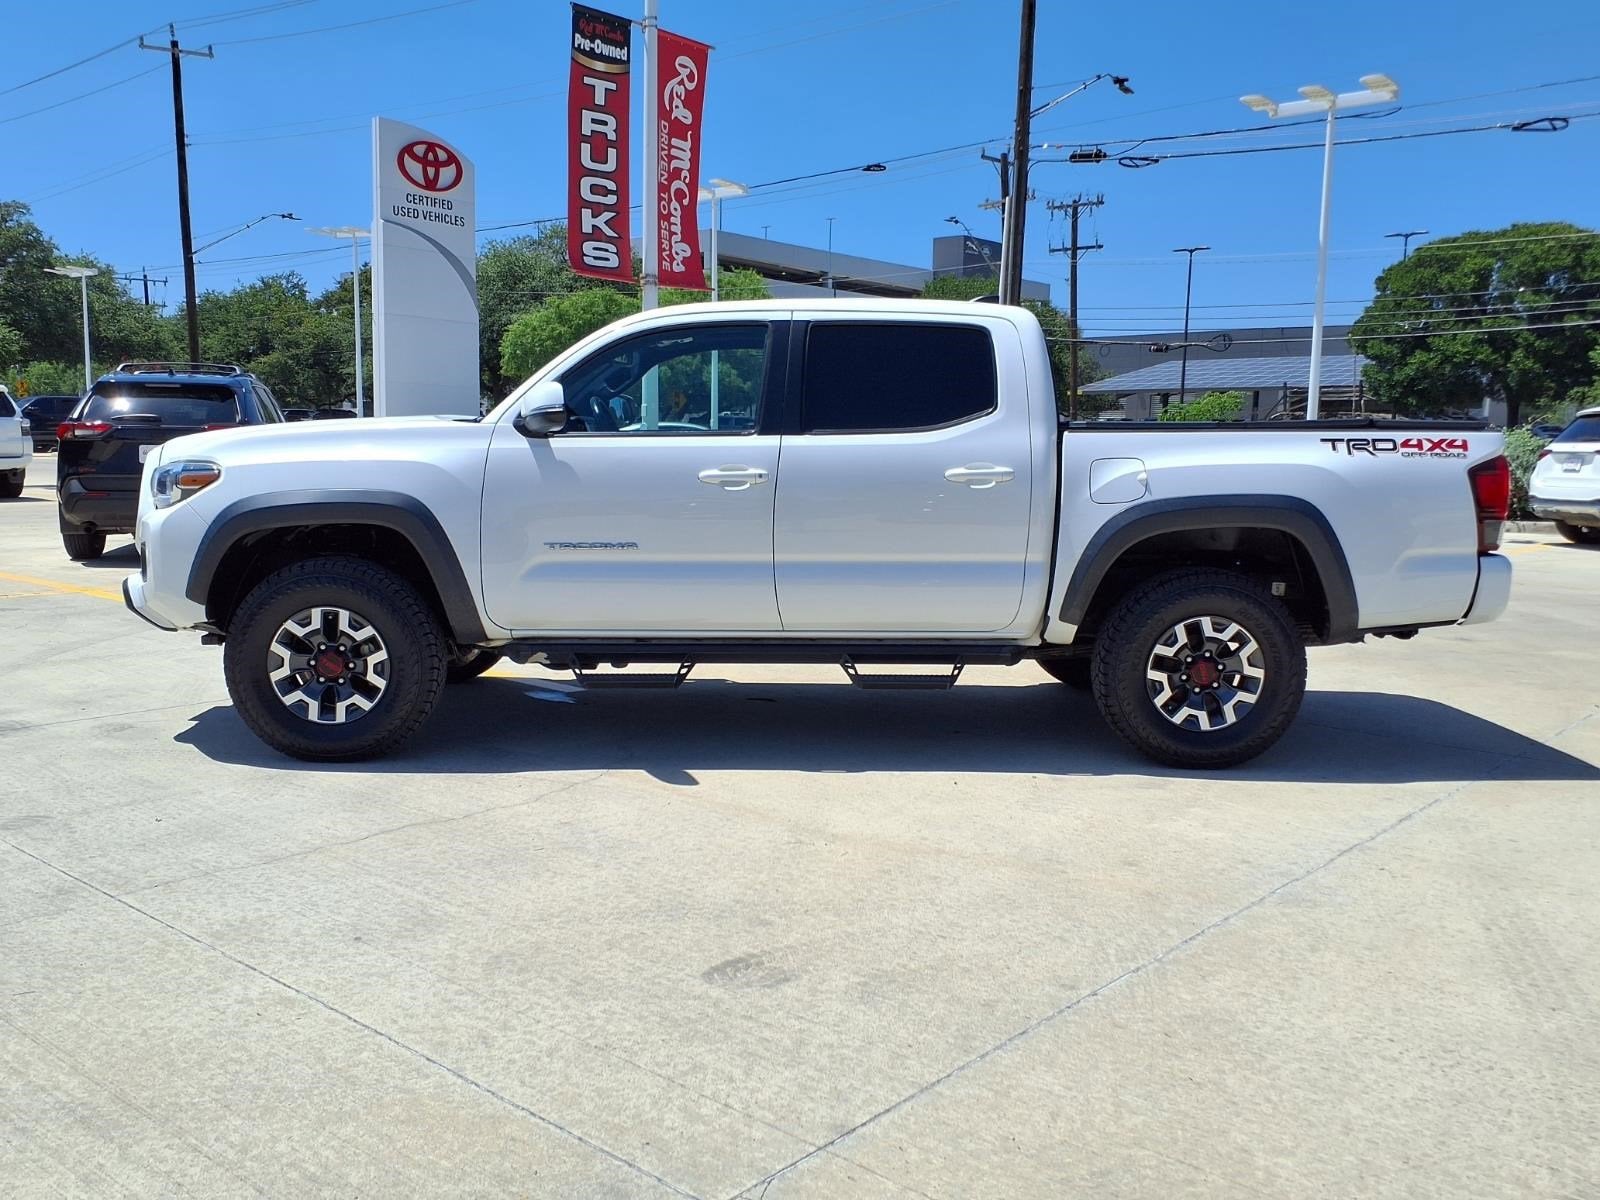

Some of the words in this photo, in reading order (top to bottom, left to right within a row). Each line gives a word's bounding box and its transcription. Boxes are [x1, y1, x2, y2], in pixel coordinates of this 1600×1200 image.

[574, 32, 628, 61] Pre-Owned
[664, 55, 698, 125] Red
[660, 119, 669, 185] DRIVEN
[580, 76, 620, 268] TRUCKS
[405, 192, 453, 211] CERTIFIED
[660, 191, 669, 215] TO
[392, 205, 420, 219] USED
[421, 210, 465, 227] VEHICLES
[660, 220, 671, 272] SERVE
[1319, 438, 1399, 458] TRD
[543, 541, 639, 551] TACOMA
